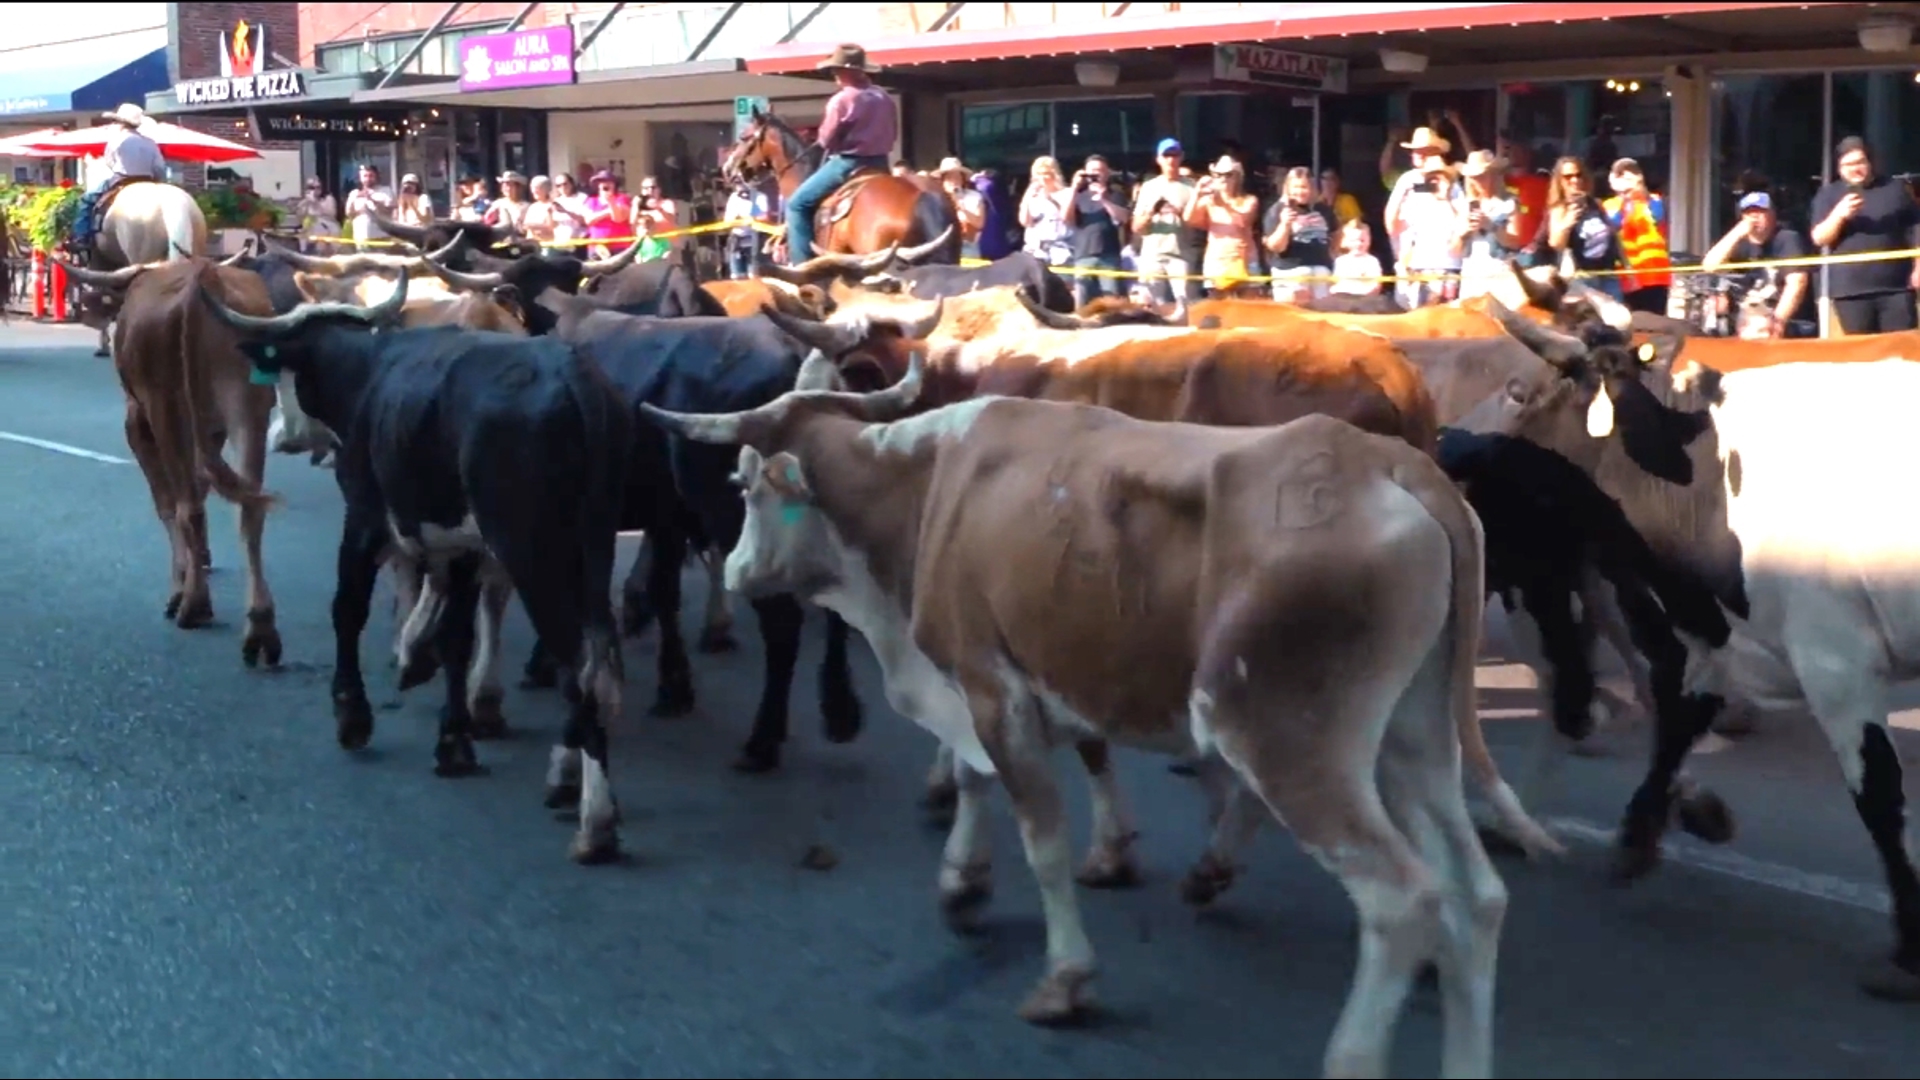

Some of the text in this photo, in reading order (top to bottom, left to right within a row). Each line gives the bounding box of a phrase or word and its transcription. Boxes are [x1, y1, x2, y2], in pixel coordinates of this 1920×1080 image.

[513, 34, 550, 57] AURA
[494, 54, 571, 76] SALON AND SPA
[1236, 46, 1328, 78] MAZATLAN
[175, 72, 300, 104] WICKED PIE PIZZA
